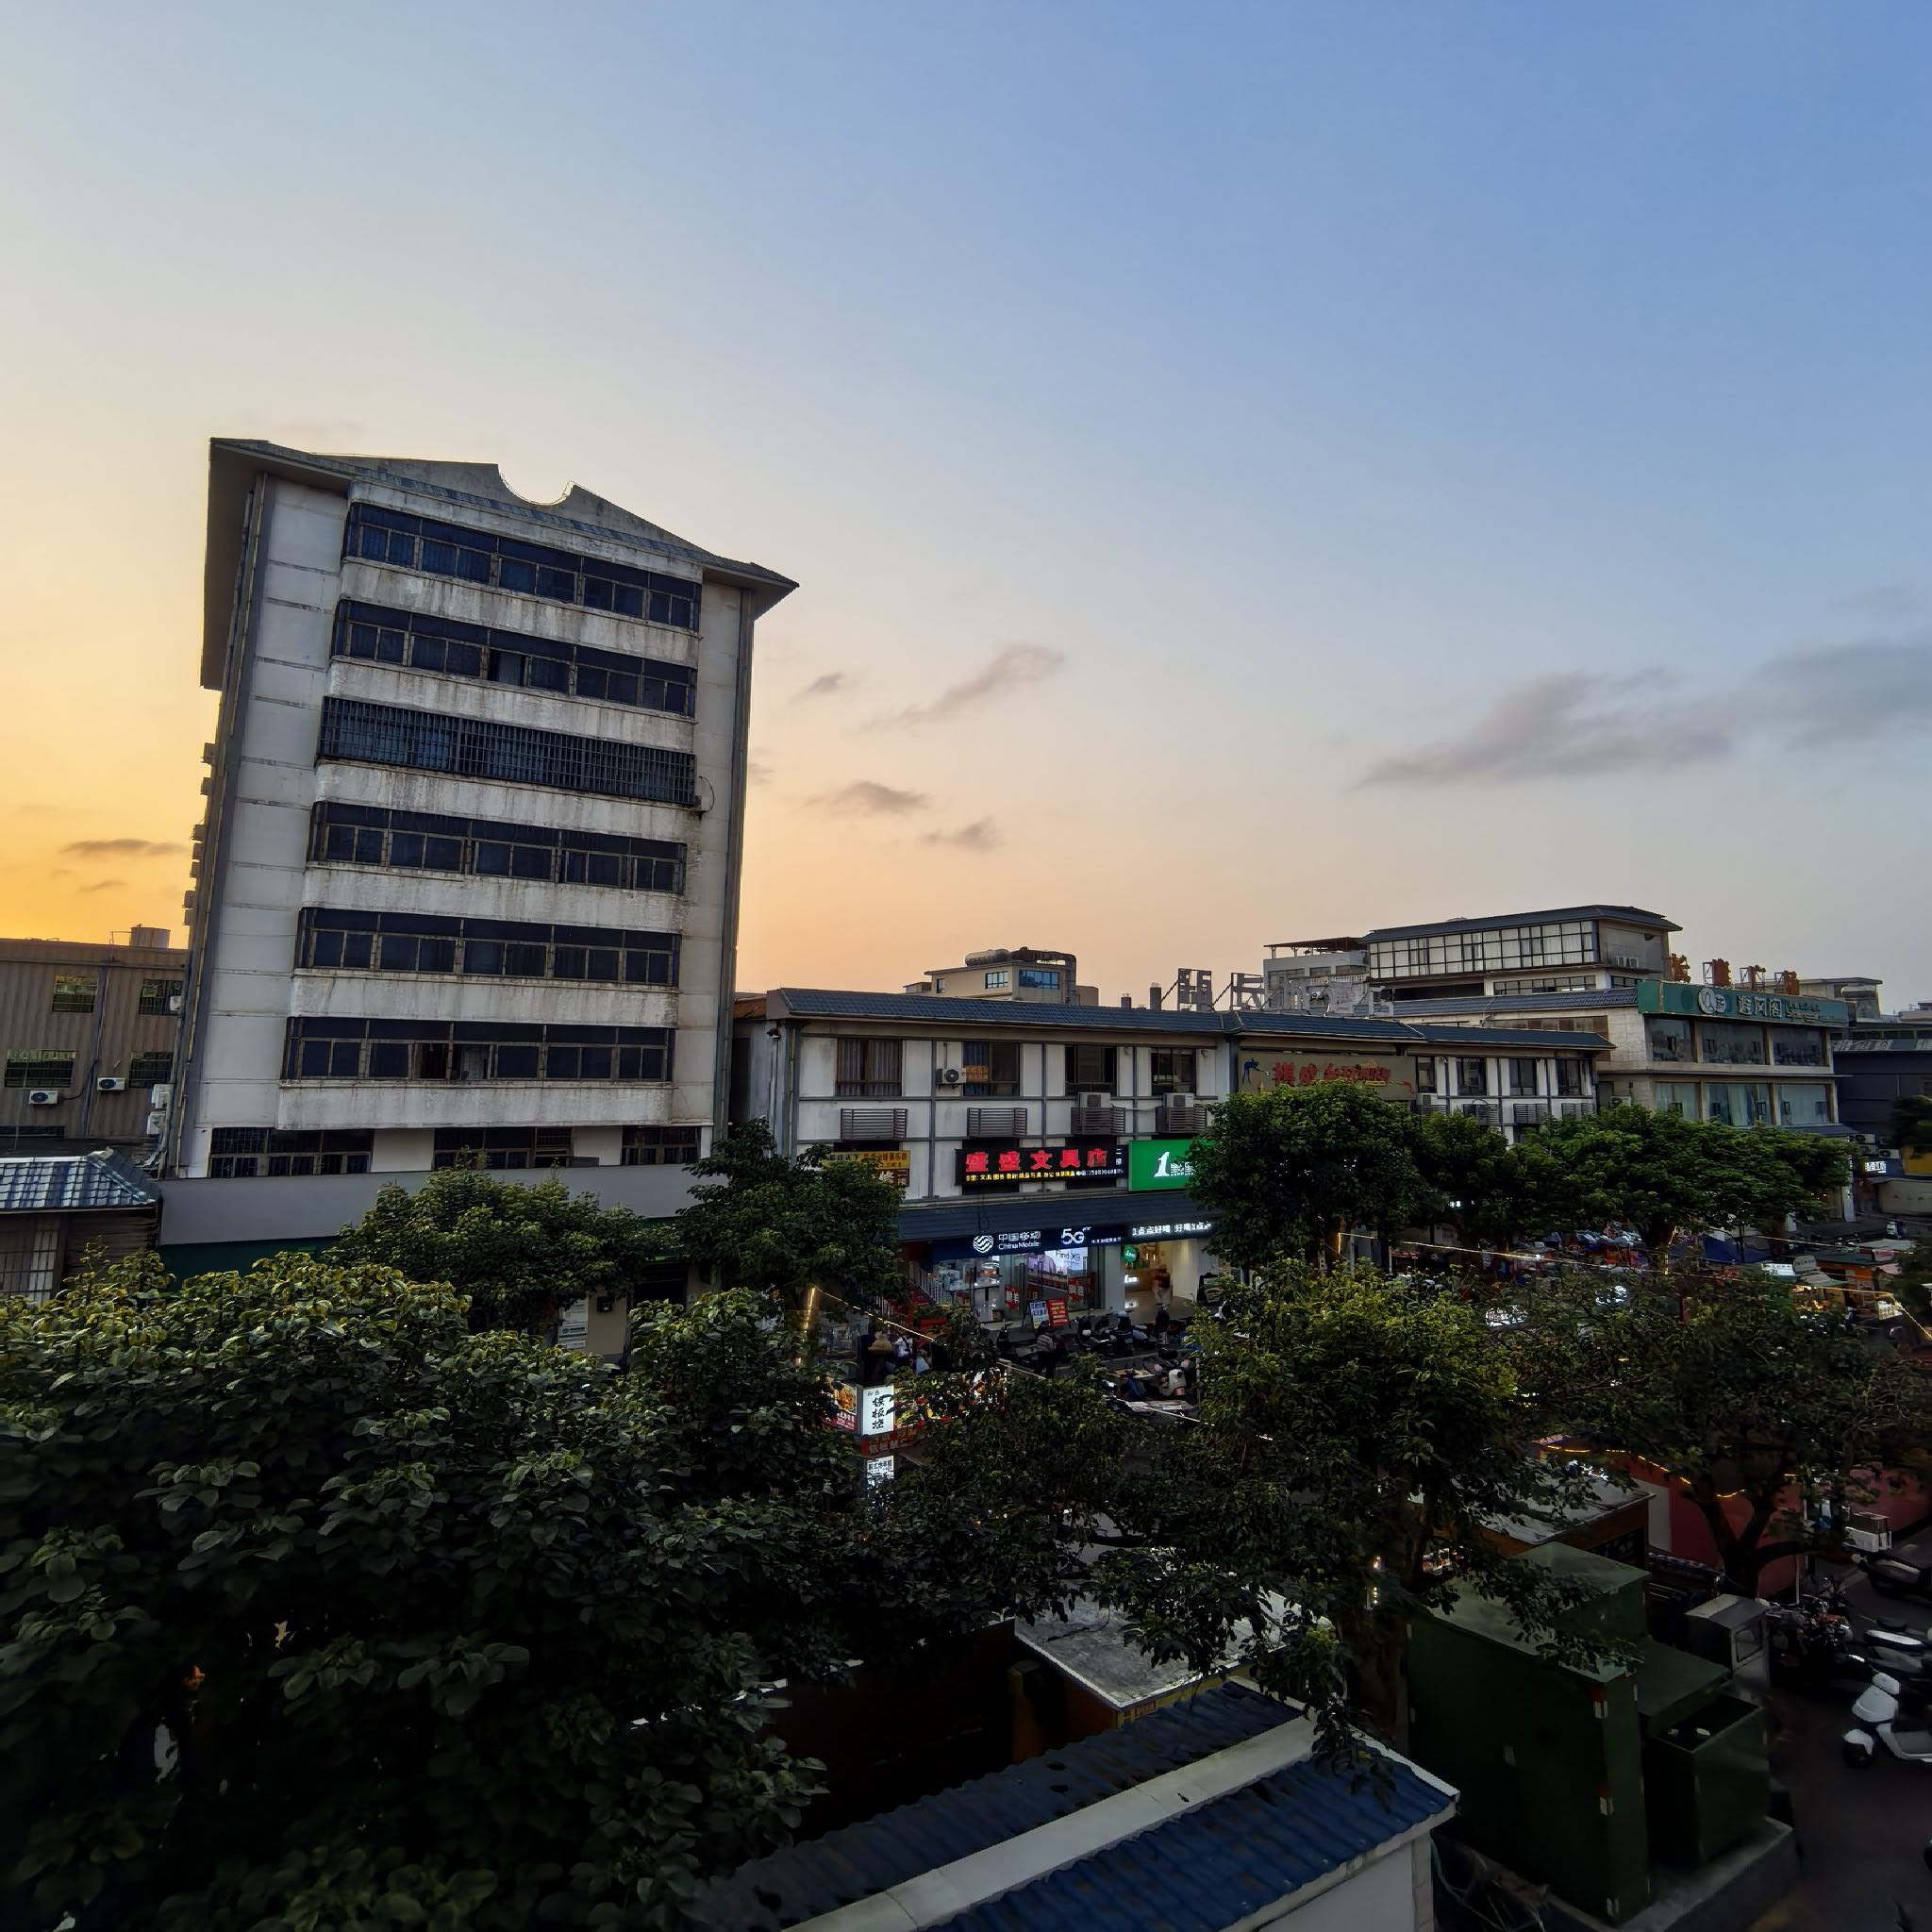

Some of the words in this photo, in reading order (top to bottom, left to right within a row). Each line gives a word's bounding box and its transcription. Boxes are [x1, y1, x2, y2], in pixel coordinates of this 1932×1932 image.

[998, 1230, 1041, 1242] 中国移动
[998, 1241, 1019, 1251] China
[1019, 1240, 1041, 1249] Mobile
